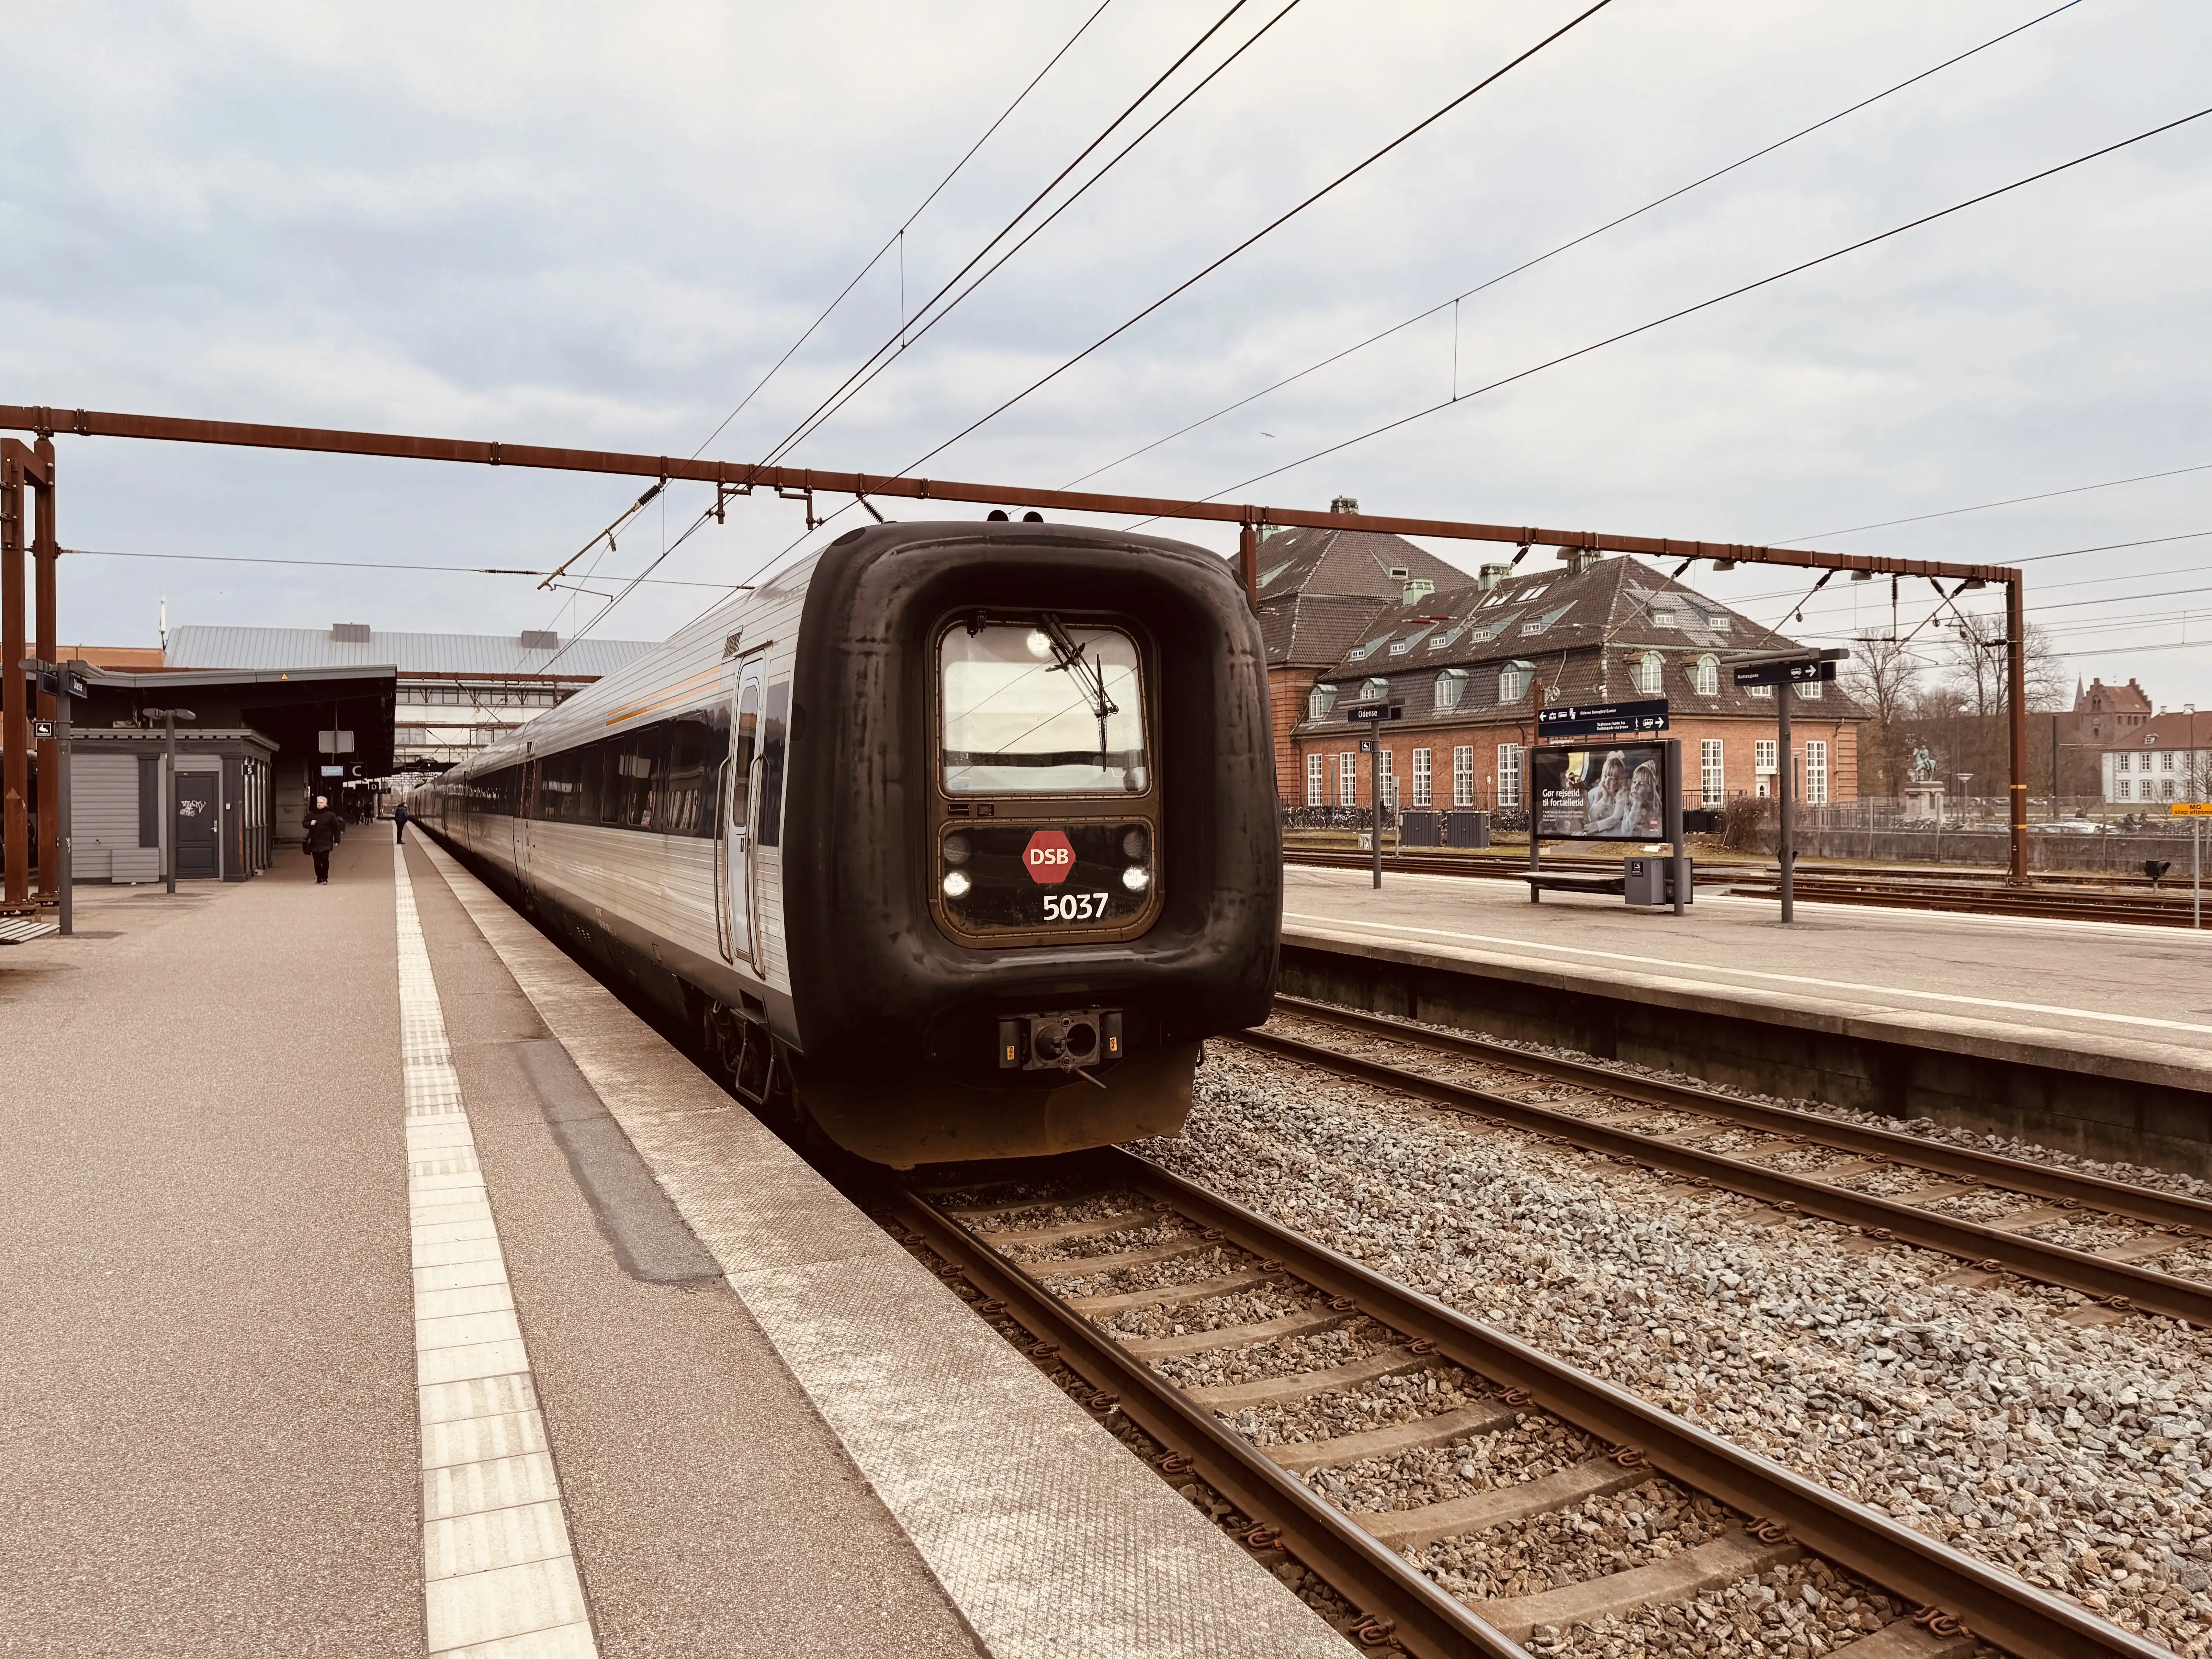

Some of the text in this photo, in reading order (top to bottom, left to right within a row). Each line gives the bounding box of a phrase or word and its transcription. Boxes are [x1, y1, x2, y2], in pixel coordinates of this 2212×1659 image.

[1358, 710, 1377, 718] Odense
[352, 765, 361, 776] C
[1556, 788, 1580, 798] rejsetid
[1550, 798, 1583, 806] fortælletid
[1030, 848, 1069, 865] DSB
[1044, 892, 1108, 921] 5037
